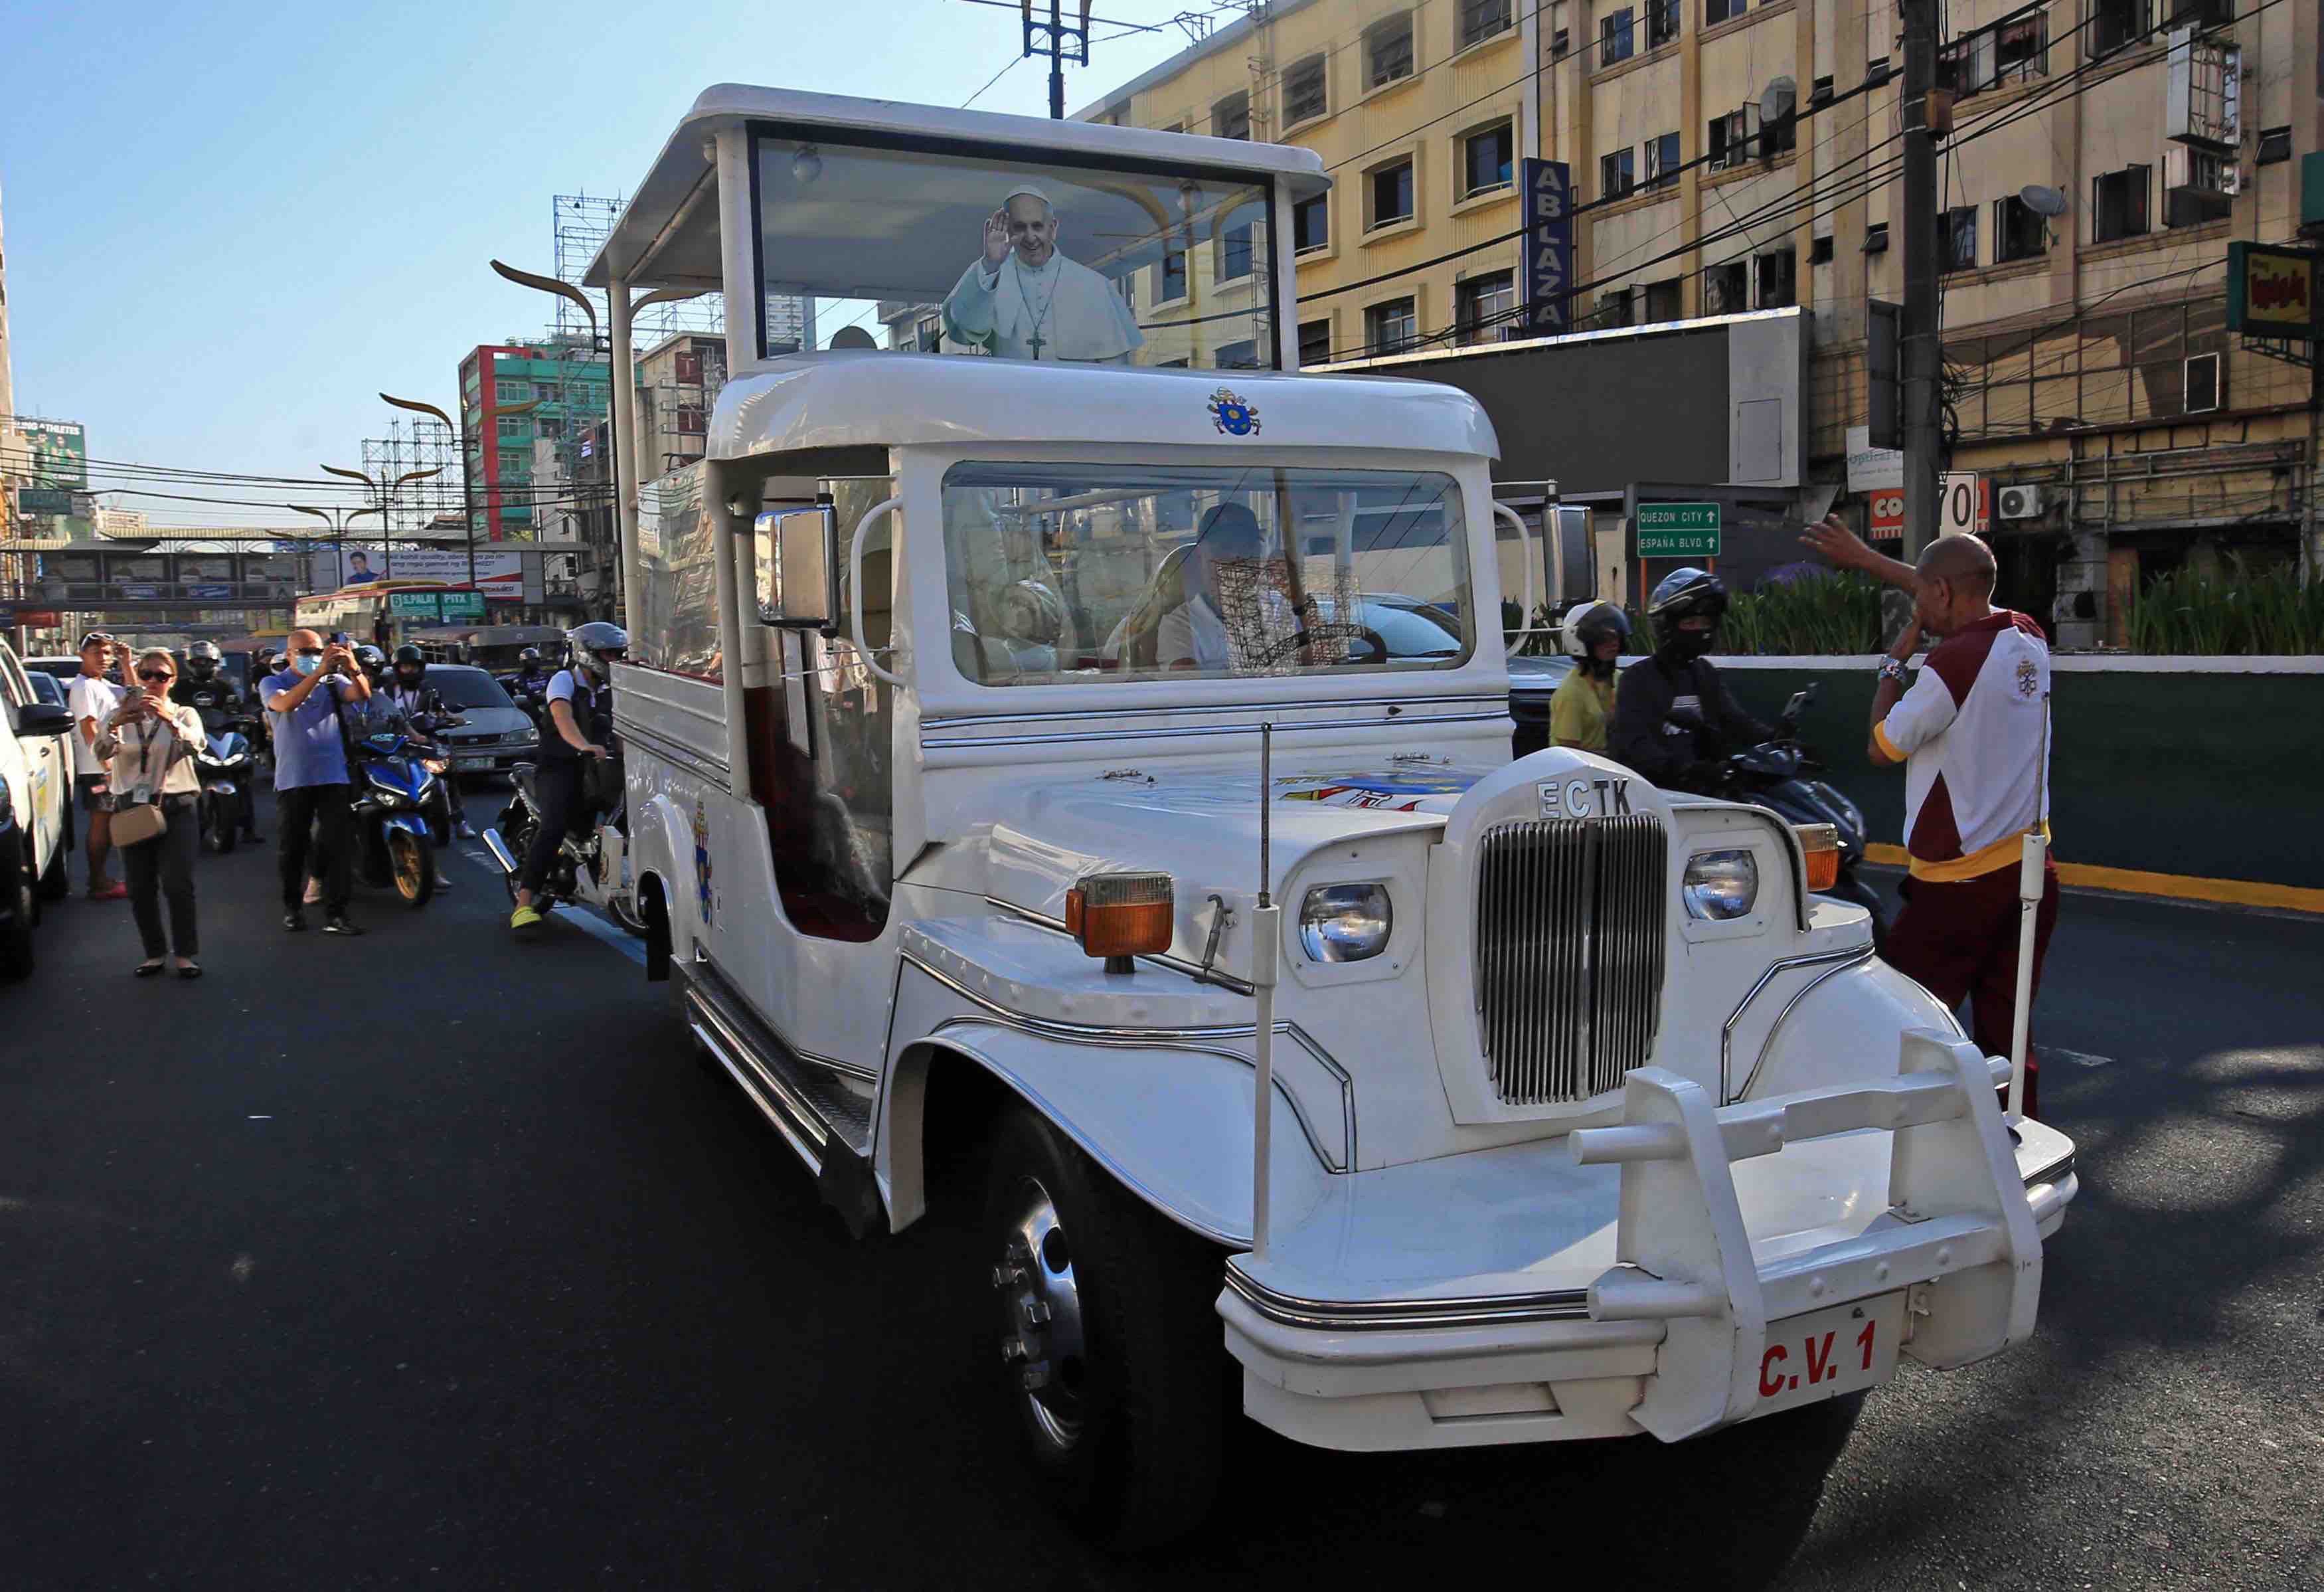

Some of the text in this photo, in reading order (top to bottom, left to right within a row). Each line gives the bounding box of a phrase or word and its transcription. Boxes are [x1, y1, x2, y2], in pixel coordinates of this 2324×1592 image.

[1535, 167, 1562, 324] ABLAZA
[1640, 511, 1702, 522] QUEZON CITY
[1641, 535, 1675, 548] ESPAÑA
[444, 594, 466, 604] PITX
[1537, 778, 1631, 819] ECTK
[1758, 1319, 1876, 1397] C.V. 1
